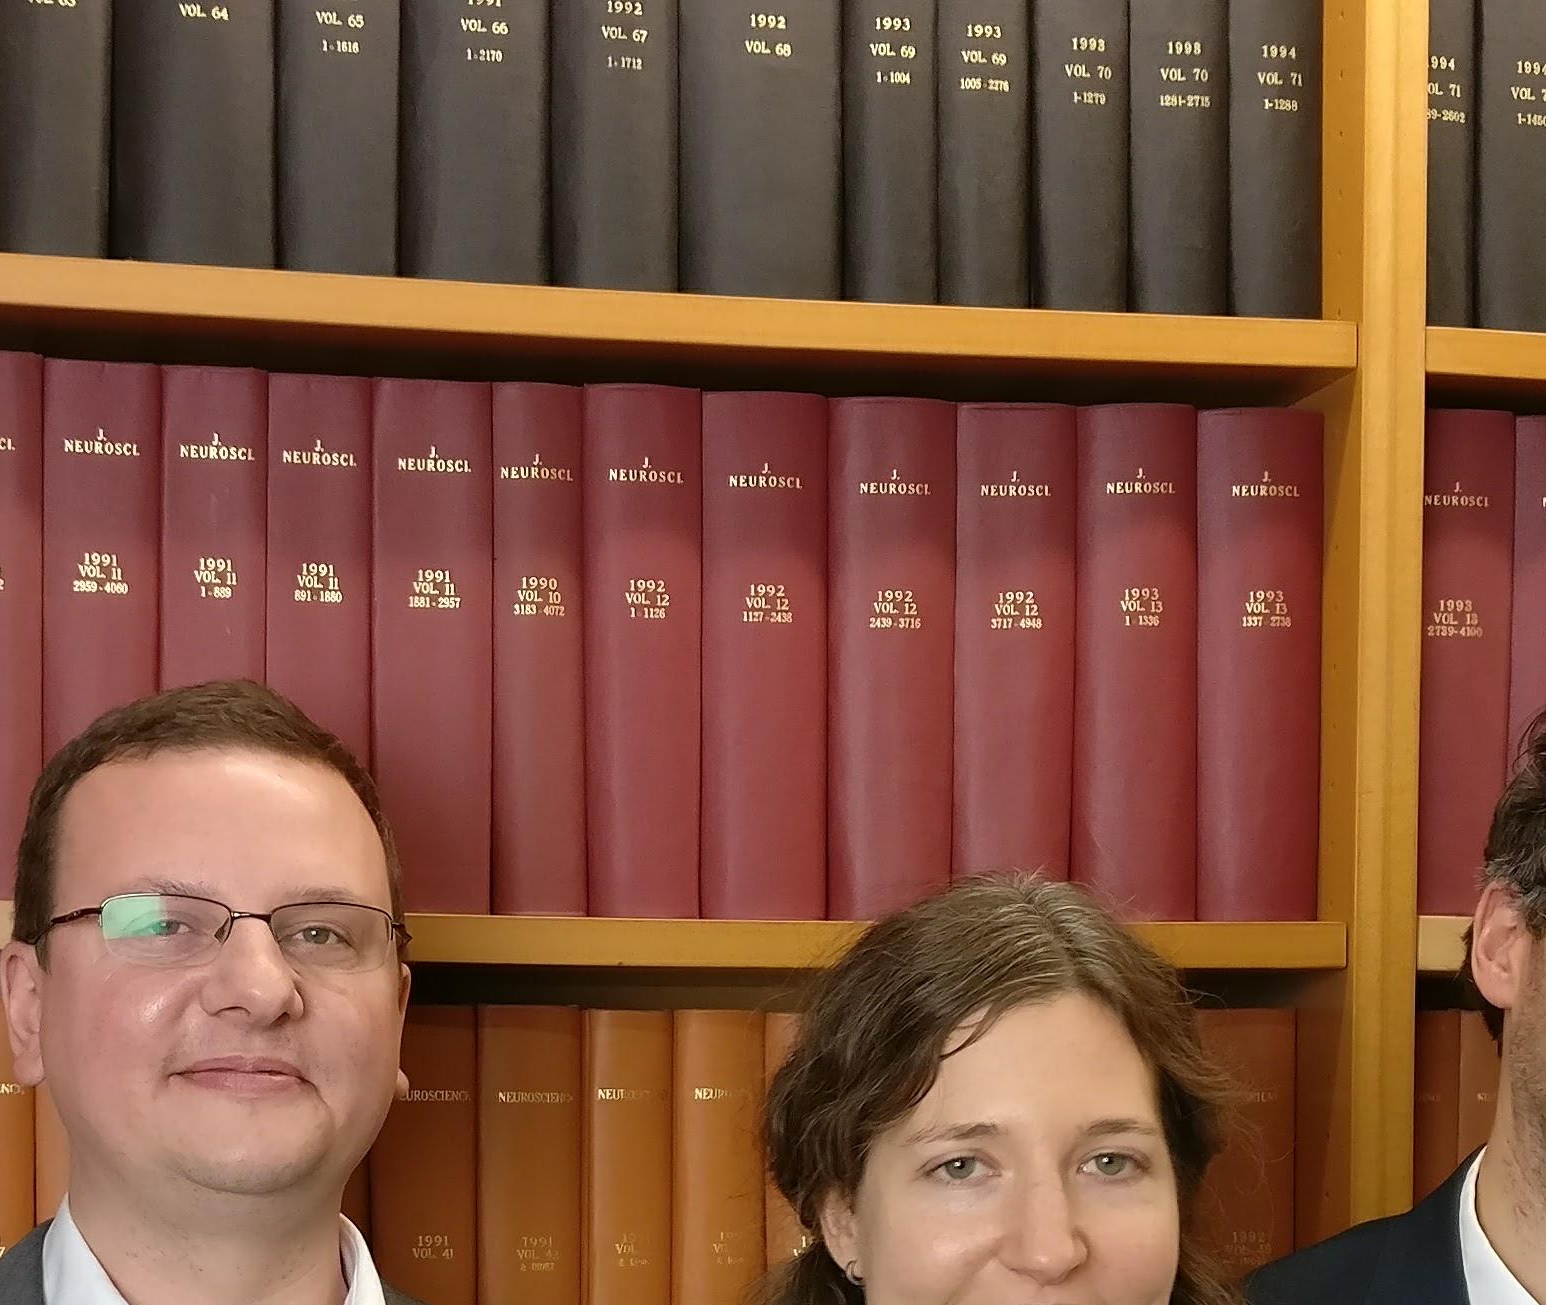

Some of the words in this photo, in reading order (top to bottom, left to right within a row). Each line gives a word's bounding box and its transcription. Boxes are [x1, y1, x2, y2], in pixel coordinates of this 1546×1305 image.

[212, 6, 229, 20] 64
[608, 0, 643, 15] 1992
[348, 15, 364, 28] 65
[750, 14, 786, 29] 1992
[875, 17, 910, 31] 1993
[492, 22, 508, 35] 66
[967, 24, 1001, 38] 1993
[633, 29, 648, 43] 67
[775, 43, 791, 57] 68
[901, 46, 915, 59] 69
[1262, 45, 1296, 59] 1994
[992, 51, 1007, 66] 69
[1097, 66, 1111, 79] 70
[1291, 72, 1302, 86] 71
[83, 553, 117, 567] 1991
[199, 558, 232, 572] 1991
[111, 568, 122, 580] 11
[302, 563, 334, 576] 1991
[418, 570, 450, 582] 1991
[225, 572, 236, 585] 11
[328, 577, 339, 590] 11
[522, 577, 557, 590] 1990
[444, 584, 455, 595] 11
[630, 580, 665, 592] 1992
[750, 584, 785, 597] 1992
[549, 591, 561, 604] 10
[656, 594, 669, 606] 12
[878, 590, 912, 602] 1992
[995, 592, 1034, 603] 1992
[1125, 588, 1158, 602] 1993
[1249, 591, 1283, 602] 1993
[776, 598, 789, 610] 12
[904, 603, 917, 615] 12
[1025, 605, 1038, 616] 12
[1150, 600, 1163, 613] 13
[1439, 599, 1472, 612] 1993
[418, 1235, 448, 1247] 1991
